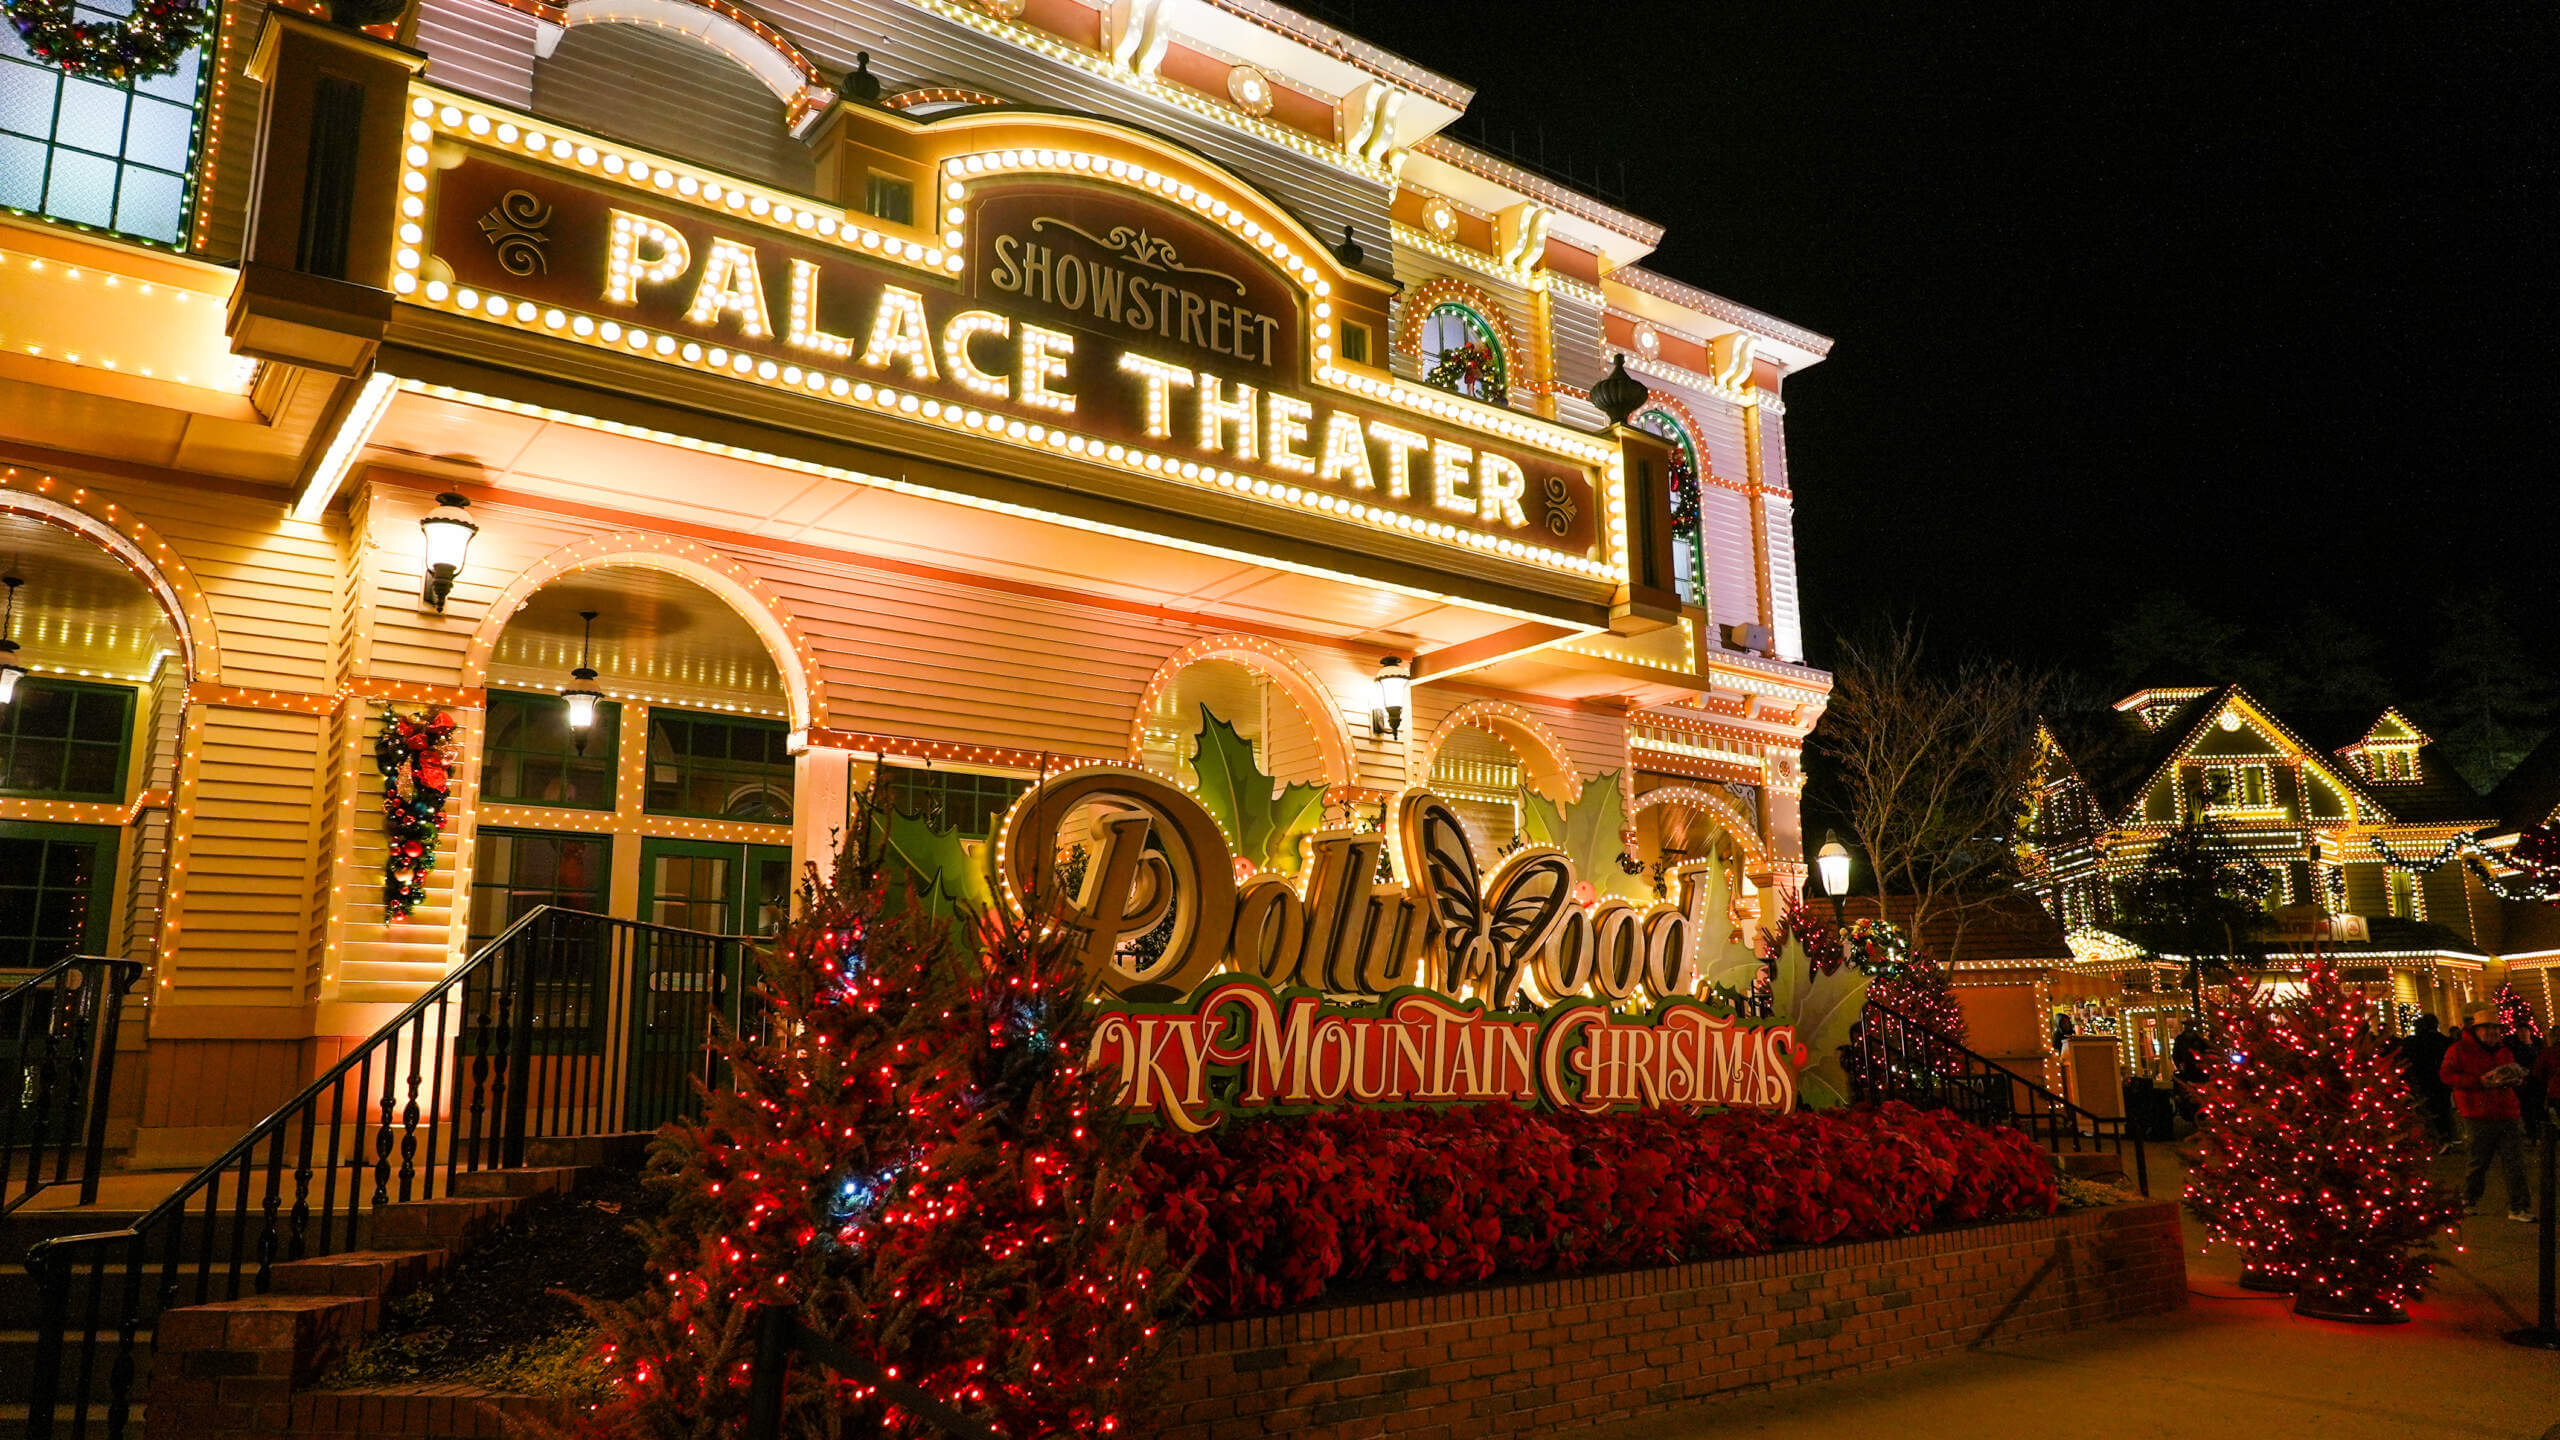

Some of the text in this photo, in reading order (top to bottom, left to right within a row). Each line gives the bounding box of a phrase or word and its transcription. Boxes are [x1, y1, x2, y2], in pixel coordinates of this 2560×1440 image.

[600, 207, 1530, 528] PALACE THEATER
[991, 234, 1279, 367] SHOWSTREET
[1086, 988, 1793, 1134] OKY MOUNTAIN CHRISTMAS
